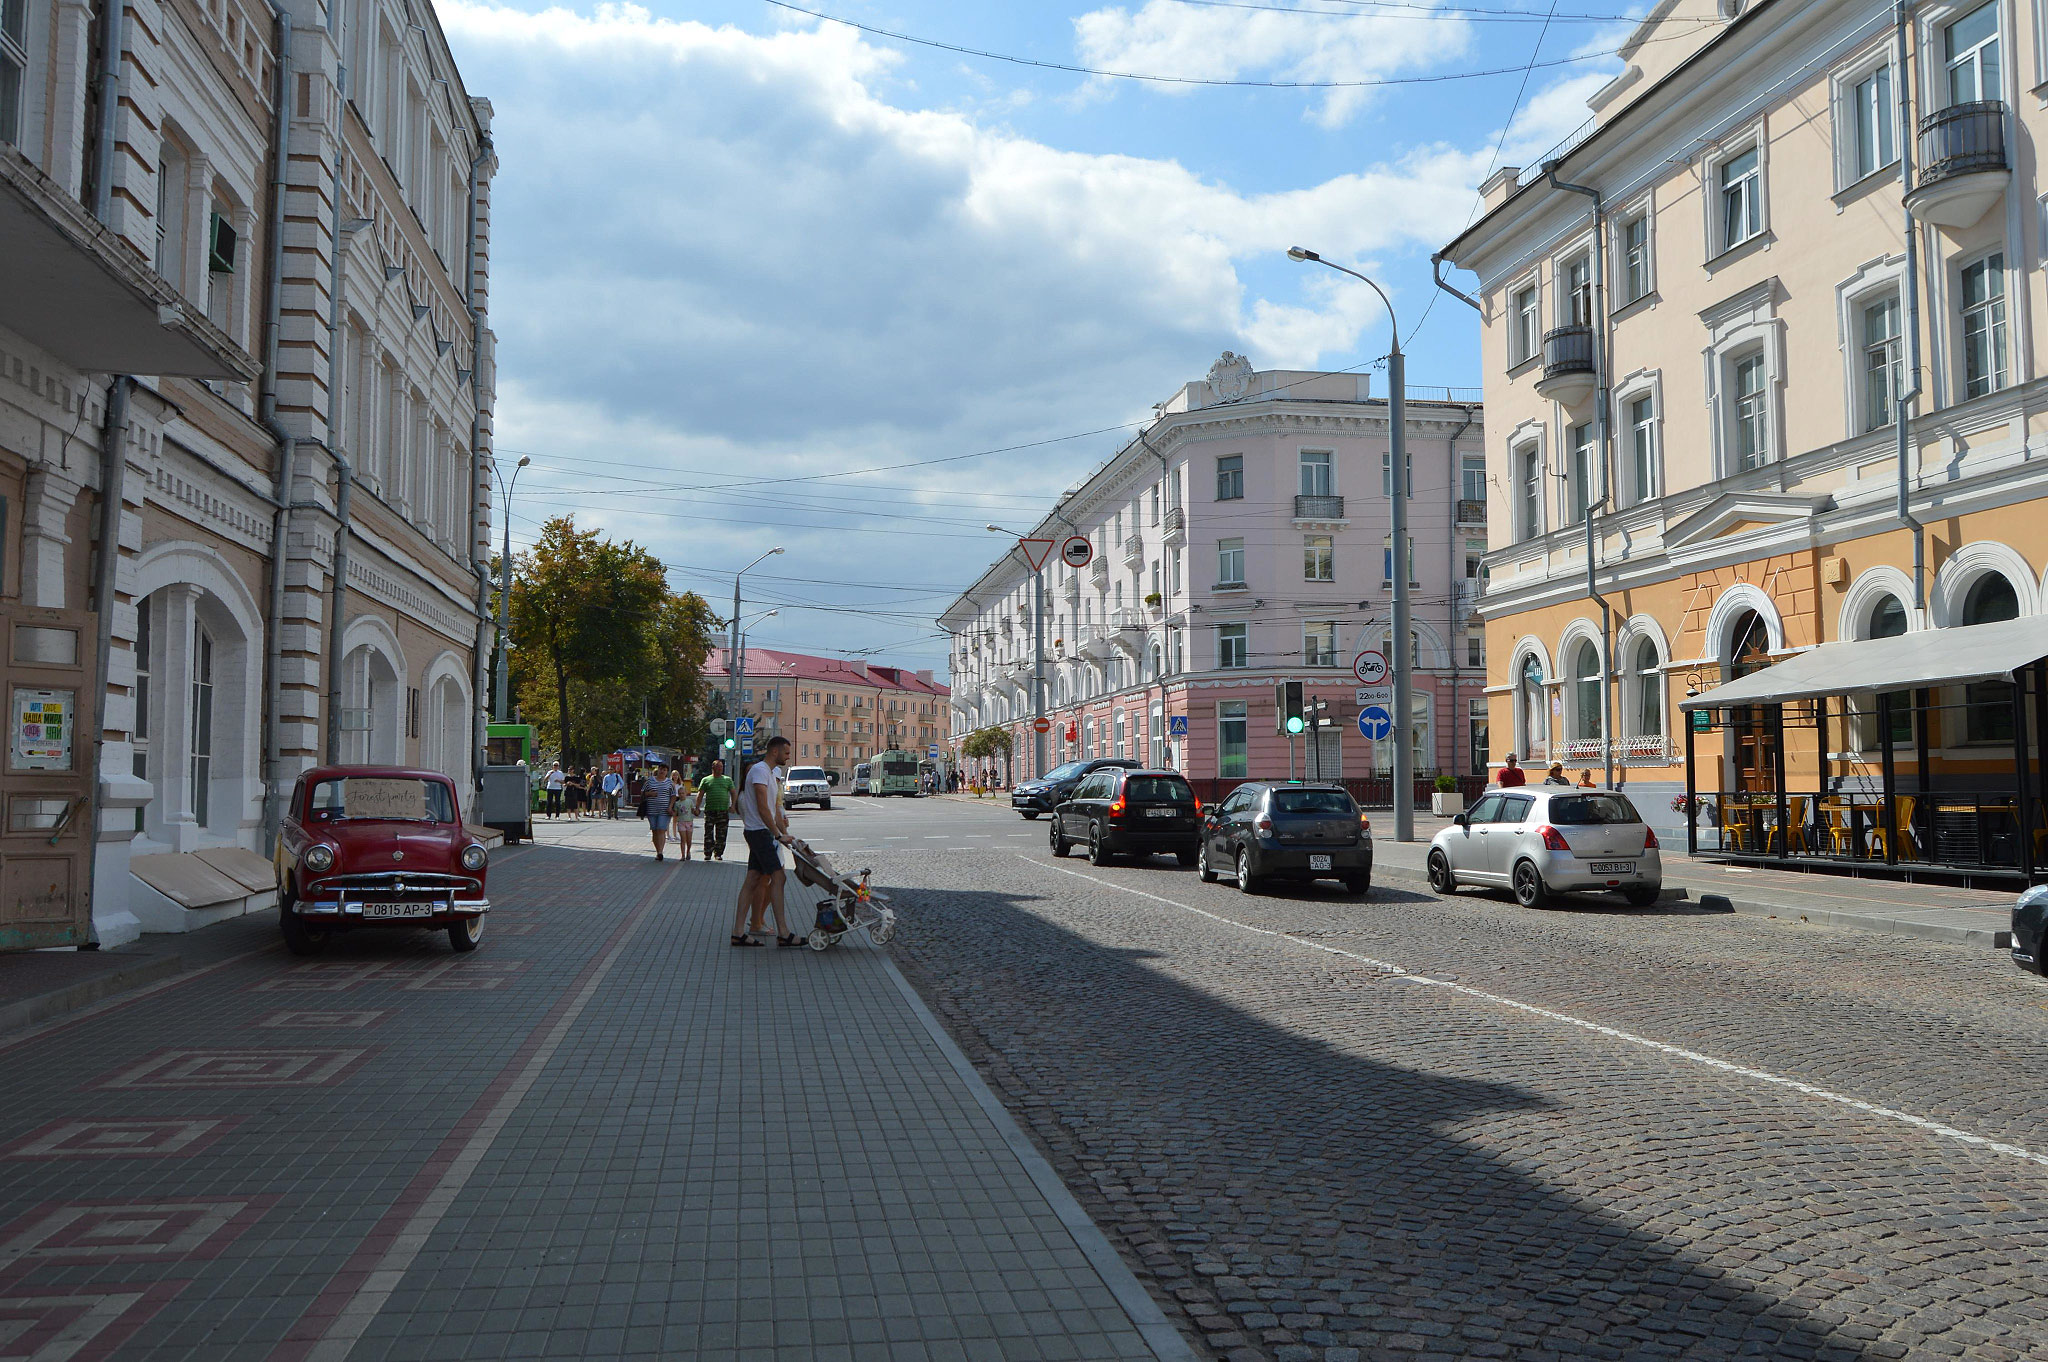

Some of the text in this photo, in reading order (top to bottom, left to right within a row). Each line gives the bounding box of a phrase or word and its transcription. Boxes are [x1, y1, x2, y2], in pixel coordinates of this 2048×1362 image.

[23, 712, 62, 725] ЧАША МИРА
[46, 724, 62, 740] ЧАЙ
[345, 788, 386, 804] Forest
[1312, 855, 1328, 863] 8024
[374, 904, 431, 916] 0815 AP-3
